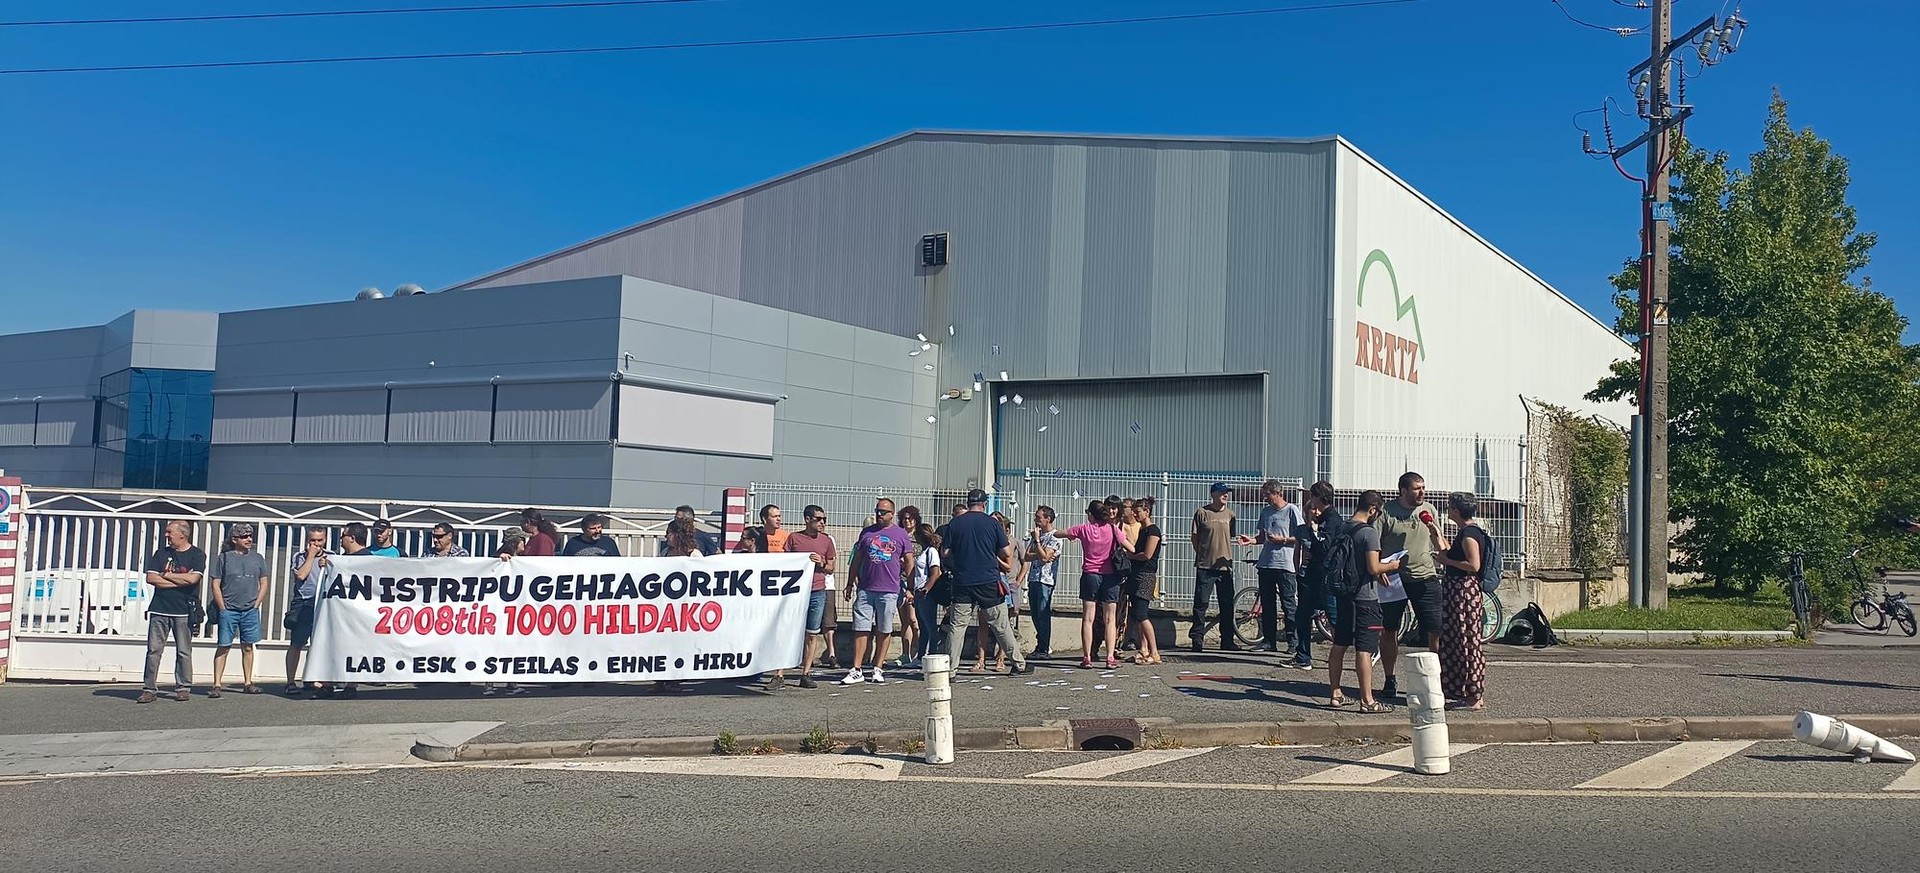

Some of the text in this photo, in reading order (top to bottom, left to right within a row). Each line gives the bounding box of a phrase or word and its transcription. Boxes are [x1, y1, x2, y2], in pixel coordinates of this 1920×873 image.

[1355, 321, 1418, 384] ARATZ
[322, 569, 804, 603] AN ISTRIPU GEHIAGORIK EZ
[375, 601, 723, 636] 2008tik 1000 HILDAKO
[345, 652, 753, 676] LAB ESK STEILAS EHNE HIRU
